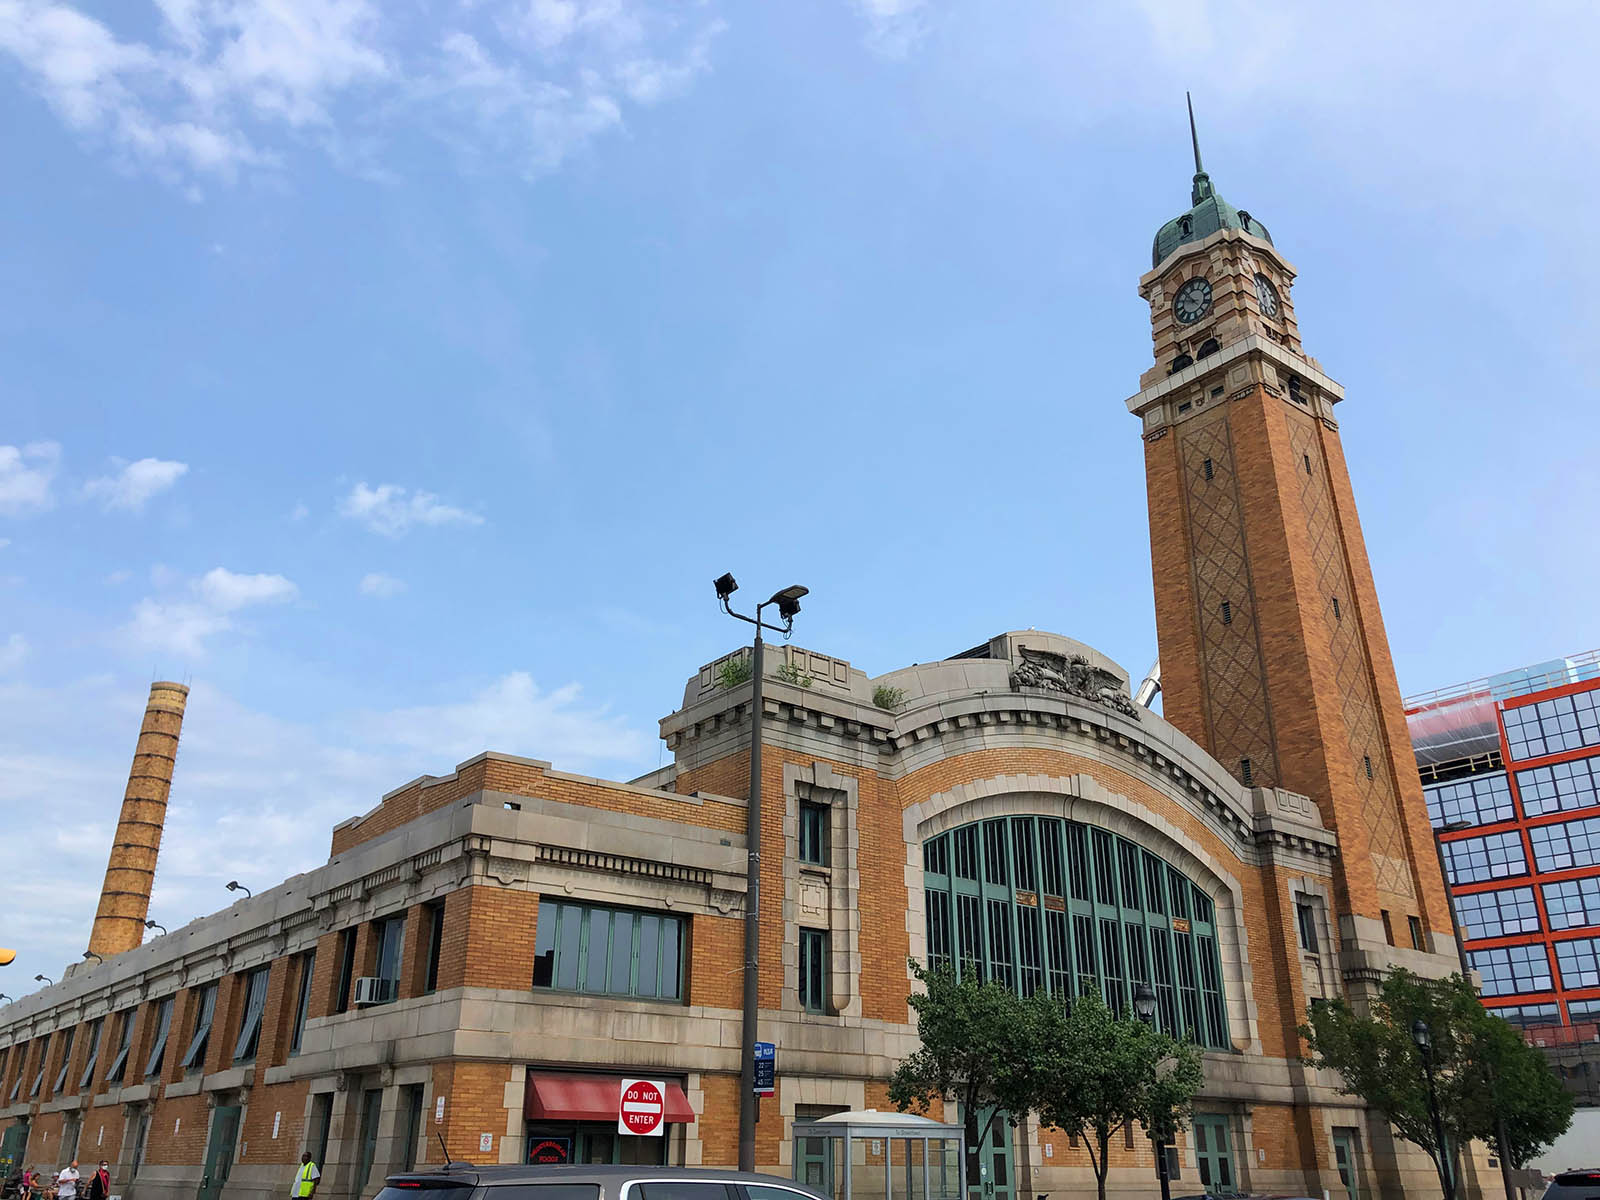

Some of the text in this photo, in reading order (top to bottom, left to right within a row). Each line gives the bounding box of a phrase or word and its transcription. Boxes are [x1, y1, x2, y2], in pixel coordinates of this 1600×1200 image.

[627, 1090, 658, 1101] DO NOT
[629, 1114, 654, 1125] ENTER
